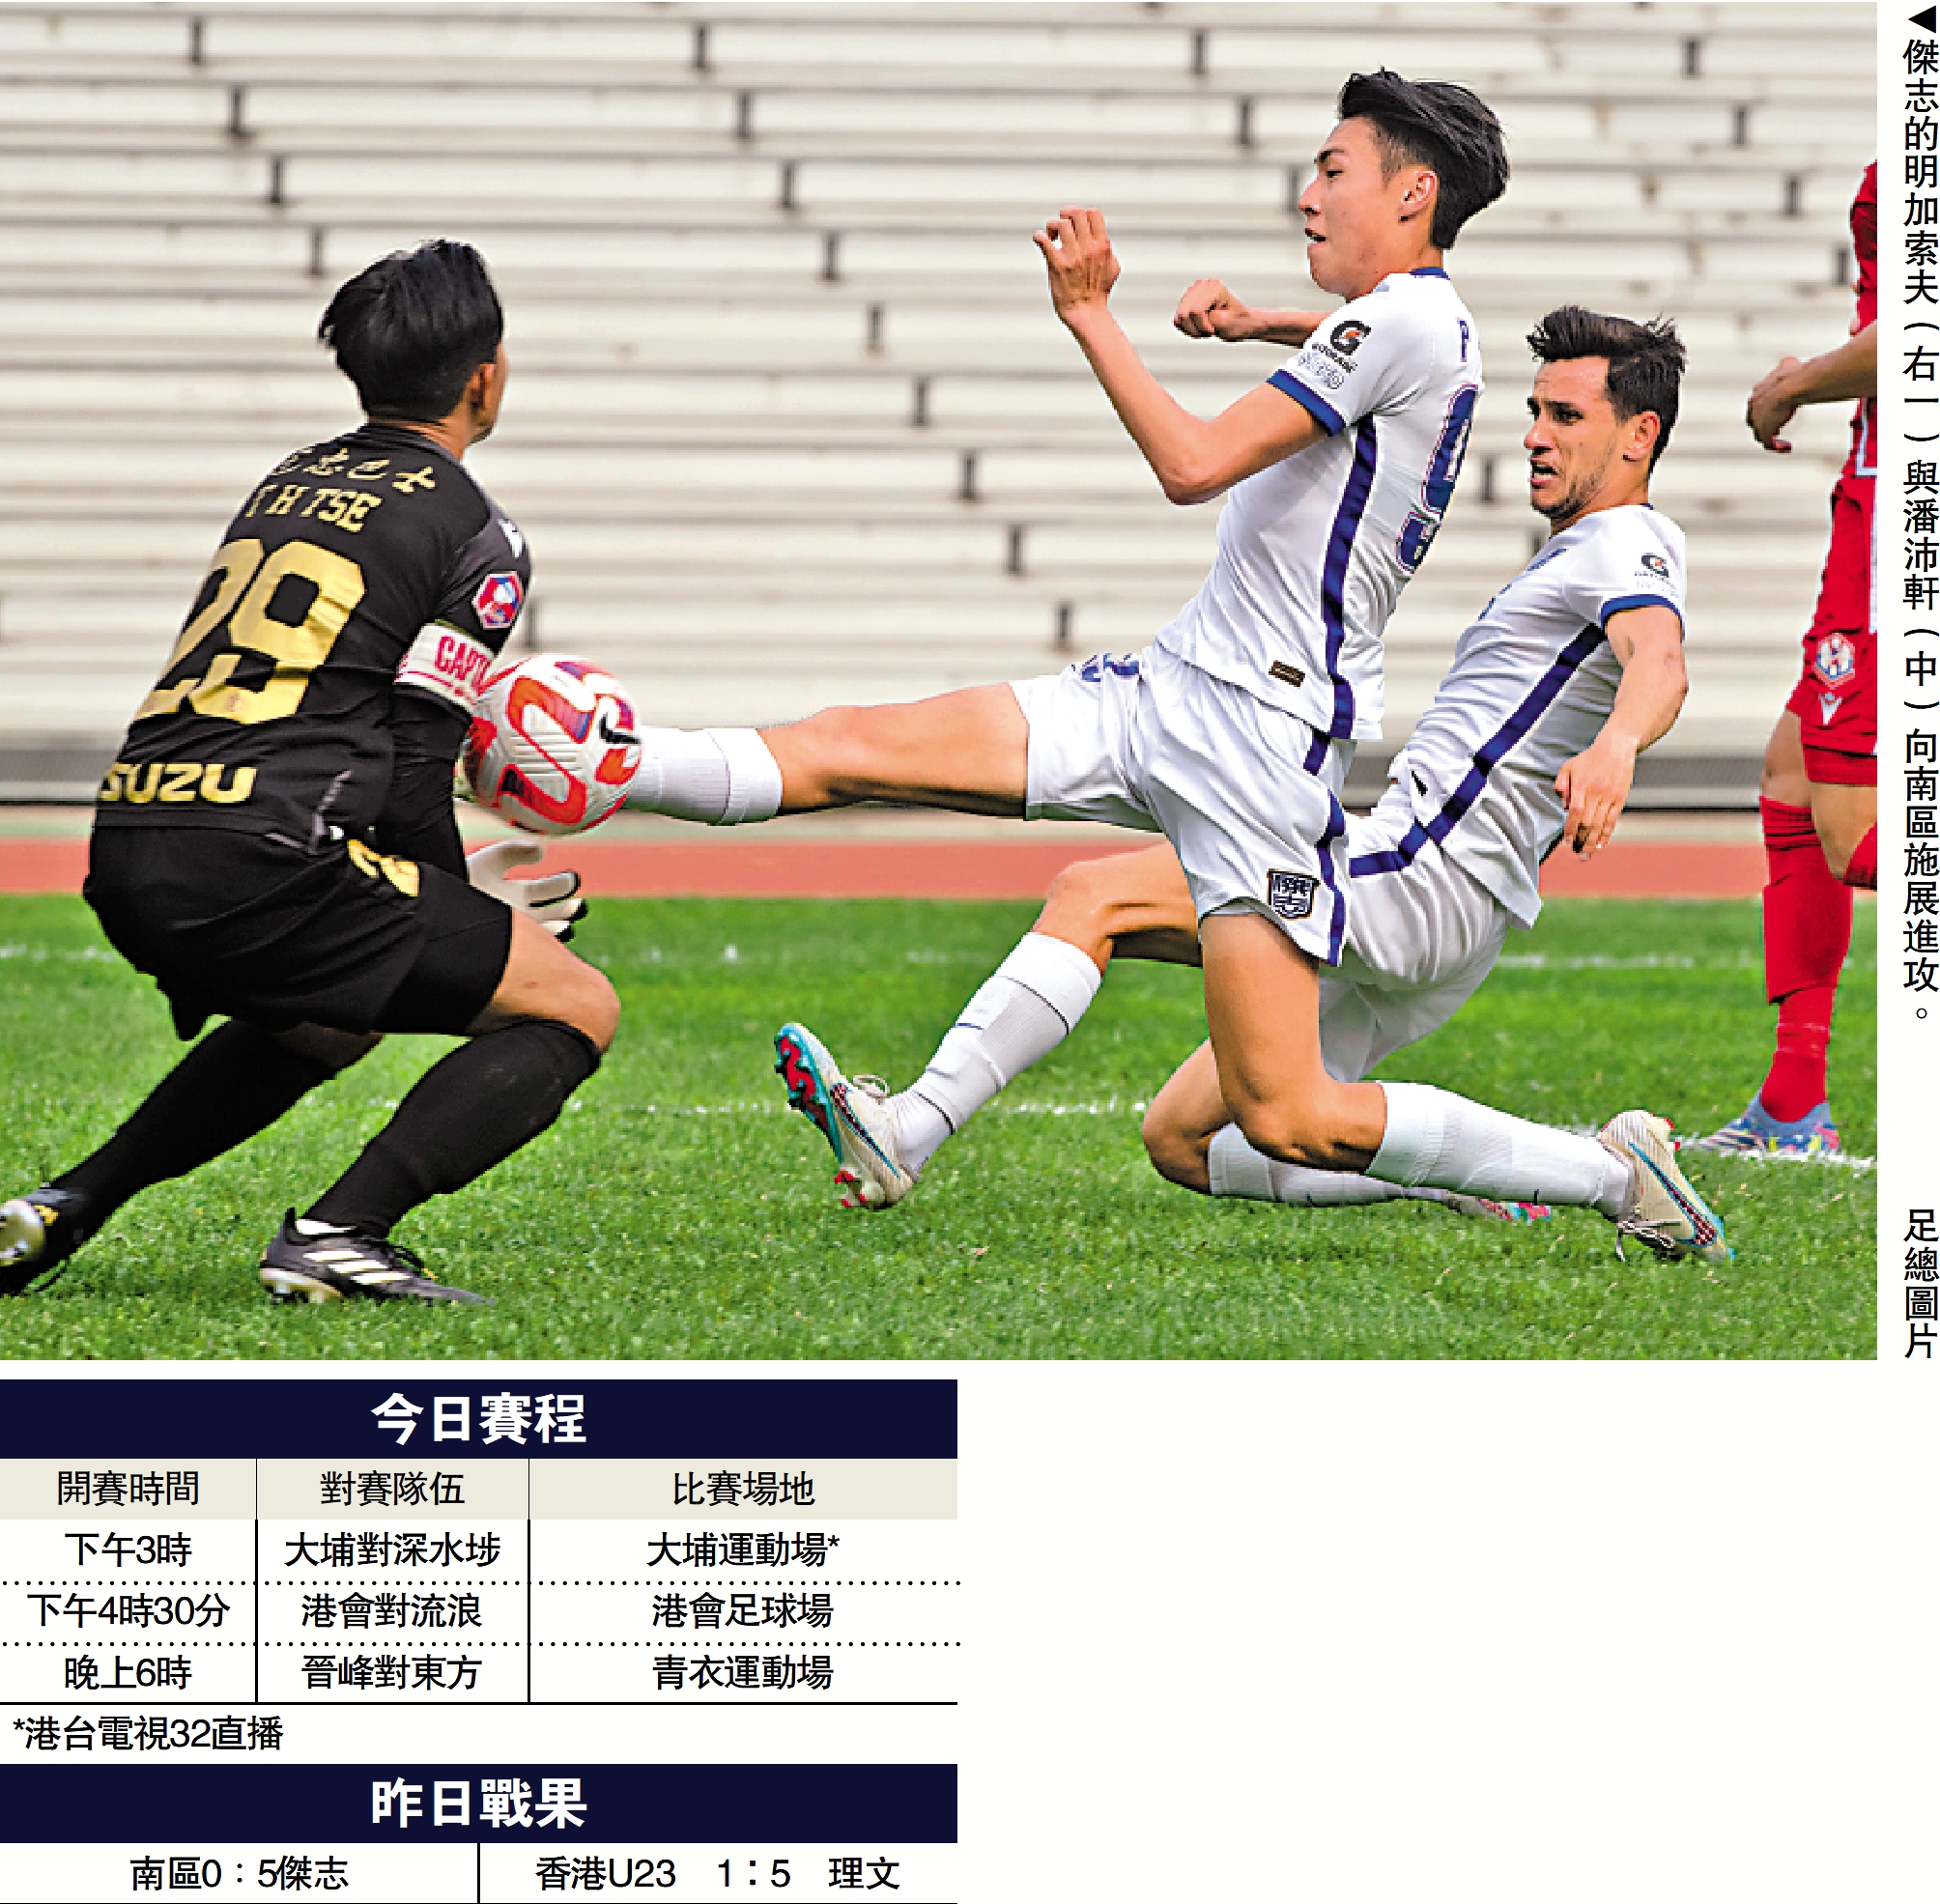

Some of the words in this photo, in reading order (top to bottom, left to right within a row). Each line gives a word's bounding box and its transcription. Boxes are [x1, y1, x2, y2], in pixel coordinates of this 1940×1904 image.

[299, 487, 384, 532] TSE
[127, 538, 365, 725] 29
[100, 762, 258, 804] SUZU
